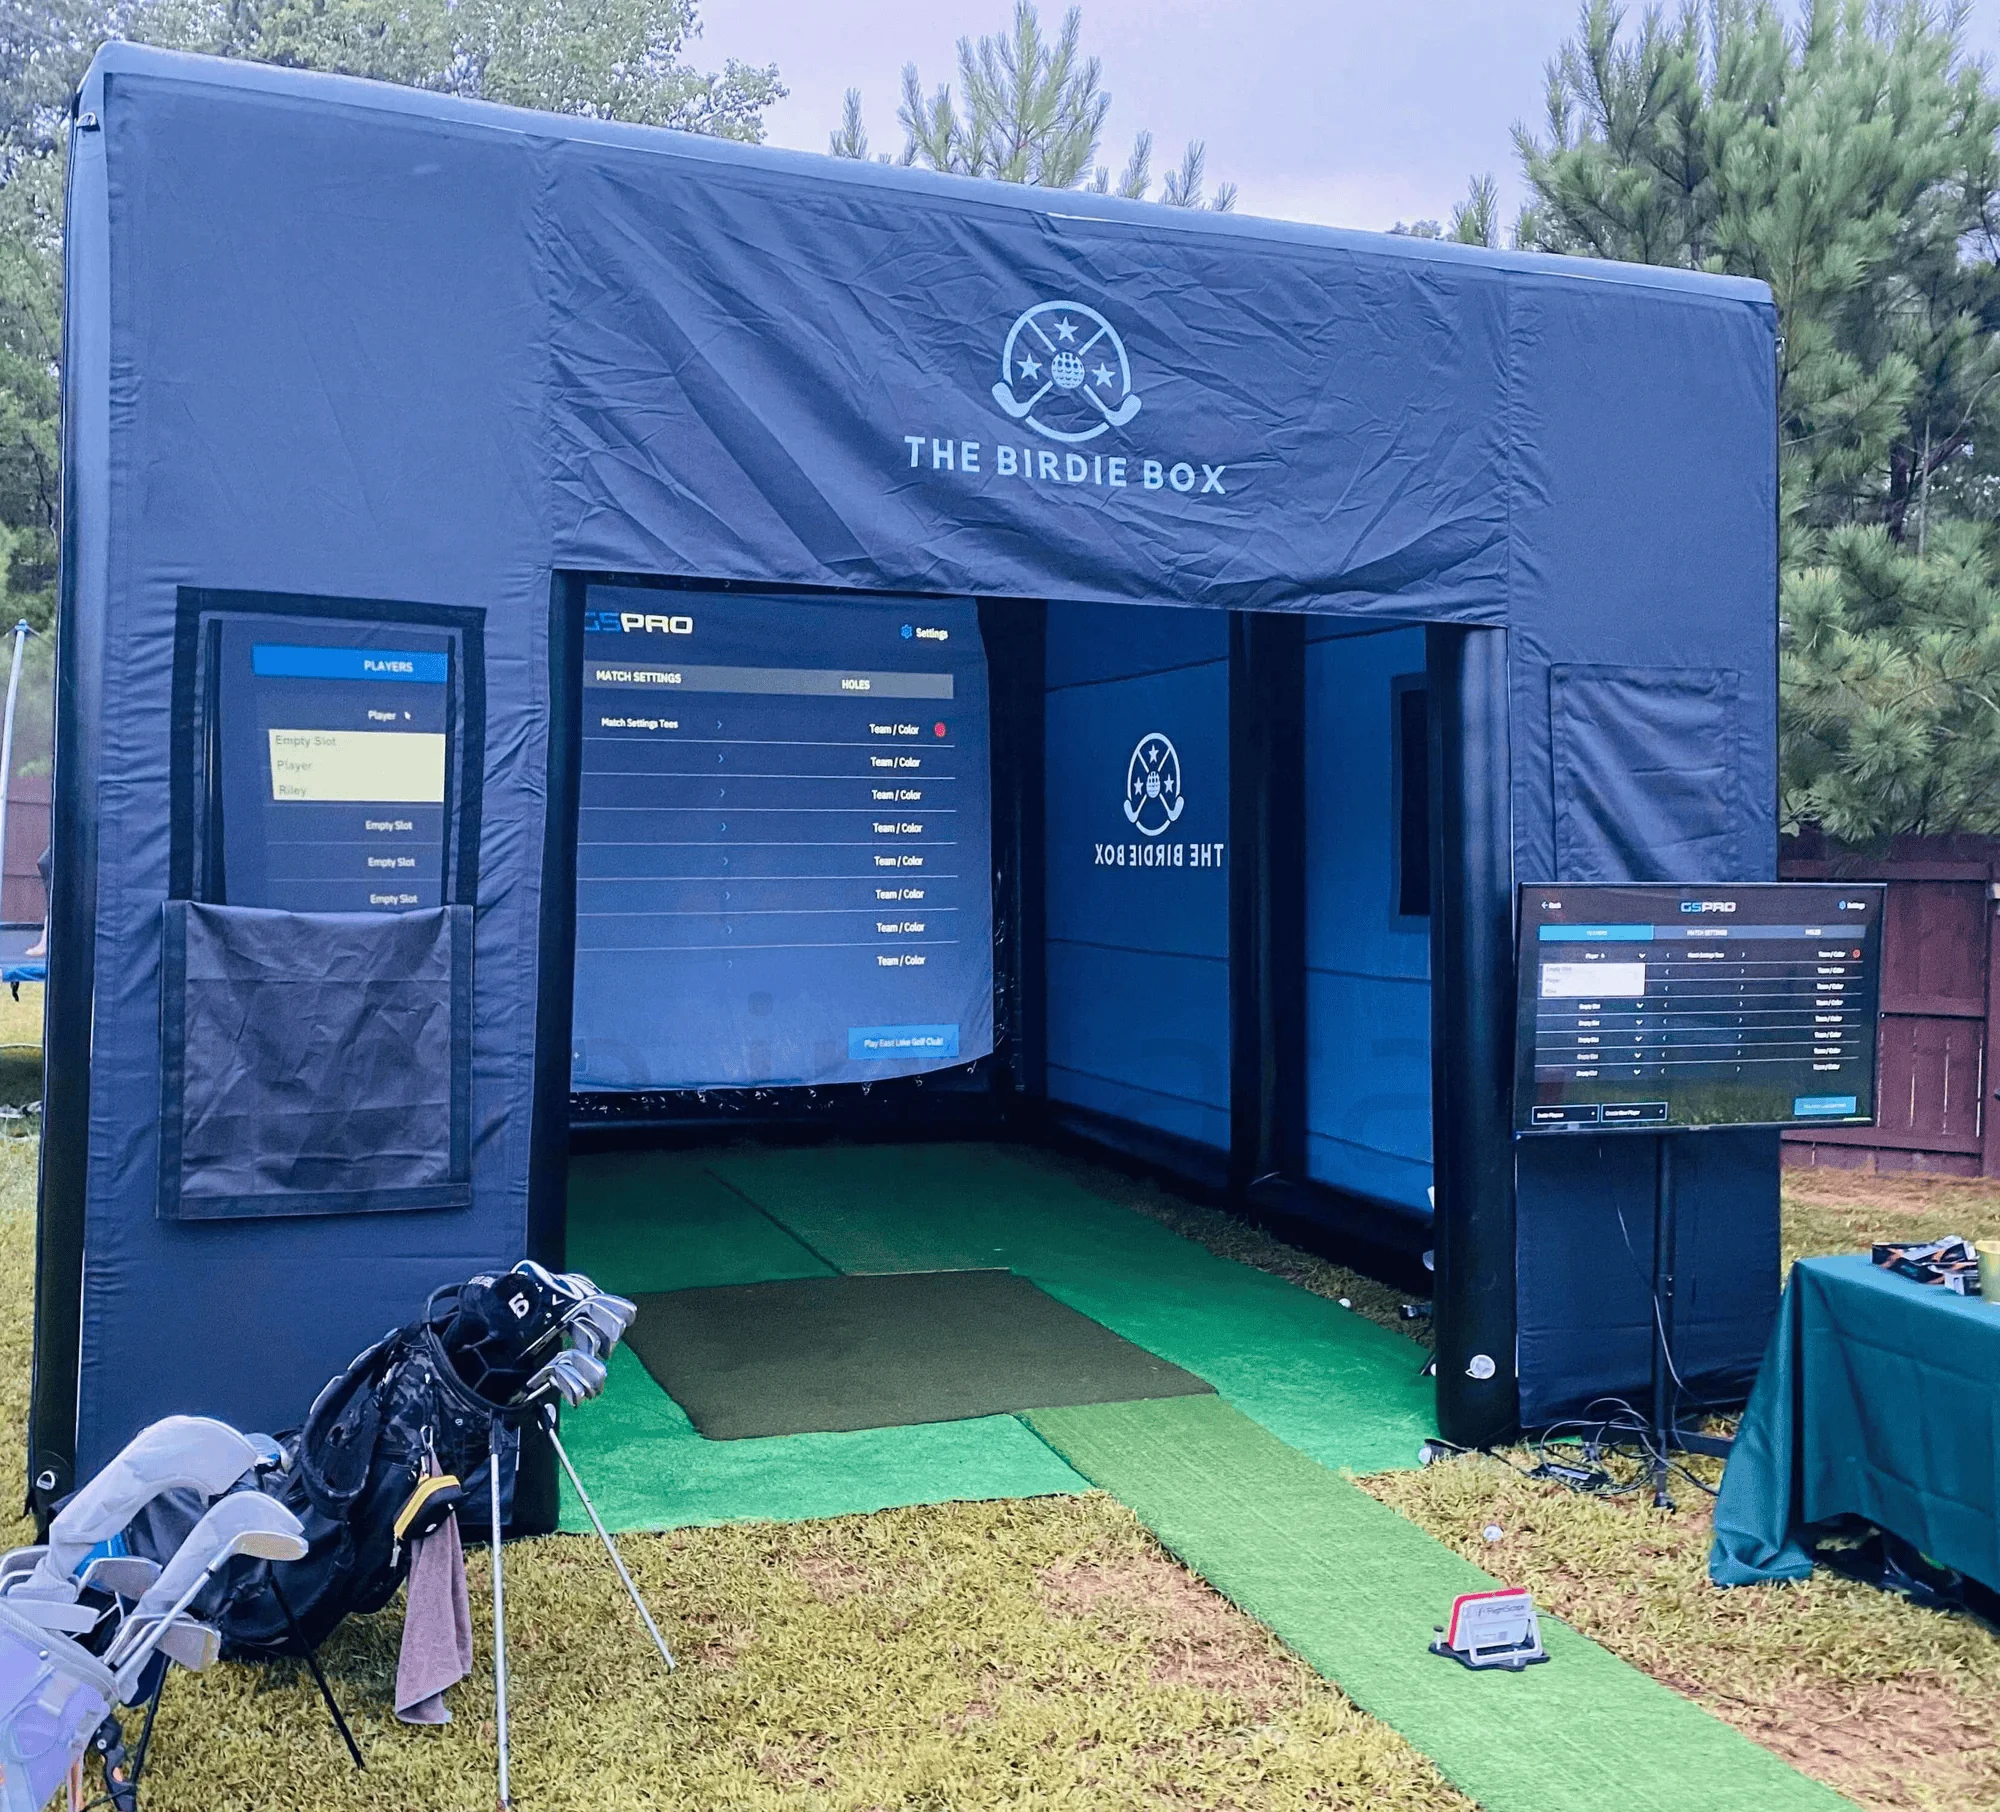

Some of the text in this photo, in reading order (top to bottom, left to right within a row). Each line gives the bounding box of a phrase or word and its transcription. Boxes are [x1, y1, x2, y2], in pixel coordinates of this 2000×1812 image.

[904, 435, 1227, 494] THE BIRDIE BOX
[916, 627, 948, 640] Settings
[363, 659, 413, 673] PLAYERS
[596, 670, 682, 684] MATCH SETTINGS
[842, 679, 870, 690] HOLES
[367, 710, 396, 722] Player
[601, 717, 678, 730] Match Settings Tees
[869, 723, 892, 734] Team
[898, 724, 920, 735] Color
[275, 735, 311, 748] Empty
[871, 756, 893, 767] Team
[899, 757, 920, 768] Color
[872, 789, 894, 800] Team
[900, 790, 921, 800] Color
[365, 820, 413, 832] Empty Slot
[873, 822, 895, 833] Team
[901, 823, 923, 833] Color
[367, 857, 416, 869] Empty Slot
[874, 855, 896, 866] Team
[902, 856, 923, 866] Color
[369, 894, 418, 906] Empty Slot
[876, 889, 897, 900] Team
[903, 889, 925, 899] Color
[1680, 901, 1737, 913] GSPRO
[877, 922, 898, 932] Team
[904, 922, 925, 932] Color
[878, 955, 899, 966] Team
[905, 955, 926, 965] Color
